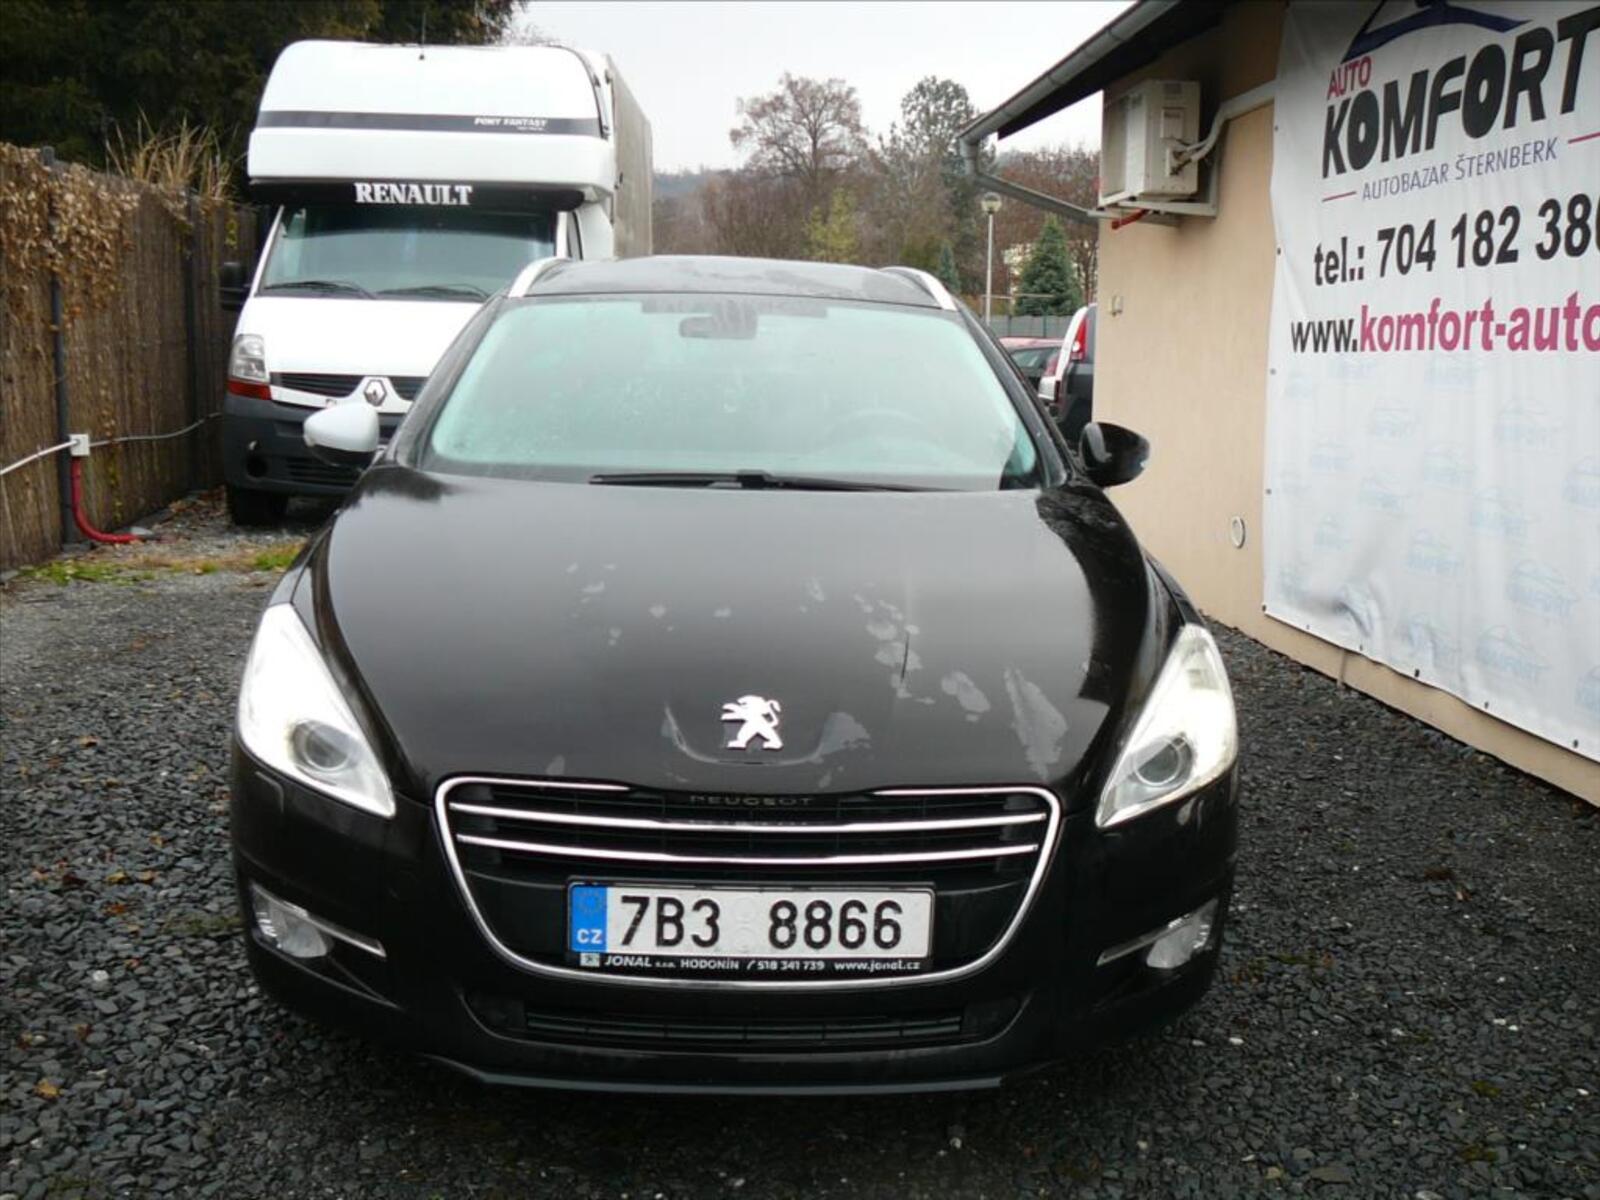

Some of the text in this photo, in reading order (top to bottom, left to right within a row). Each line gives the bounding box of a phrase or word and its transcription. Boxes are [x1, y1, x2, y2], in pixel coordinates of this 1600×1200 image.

[1322, 8, 1600, 179] KOMFORT
[1327, 56, 1372, 98] AUTO
[1362, 137, 1558, 201] AUTOBAZAR ŠTERNBERK
[354, 182, 473, 205] RENAULT
[1314, 193, 1600, 286] tel.: 704 182 38
[1290, 290, 1600, 353] www.komfort-auto
[690, 795, 812, 806] PEUGEOT
[577, 928, 603, 944] CZ
[620, 895, 903, 950] 7B3 8866
[604, 956, 652, 967] JONAL
[681, 957, 739, 970] HODONÍN
[803, 960, 825, 971] 739
[834, 959, 920, 972] www.jonal.cz
